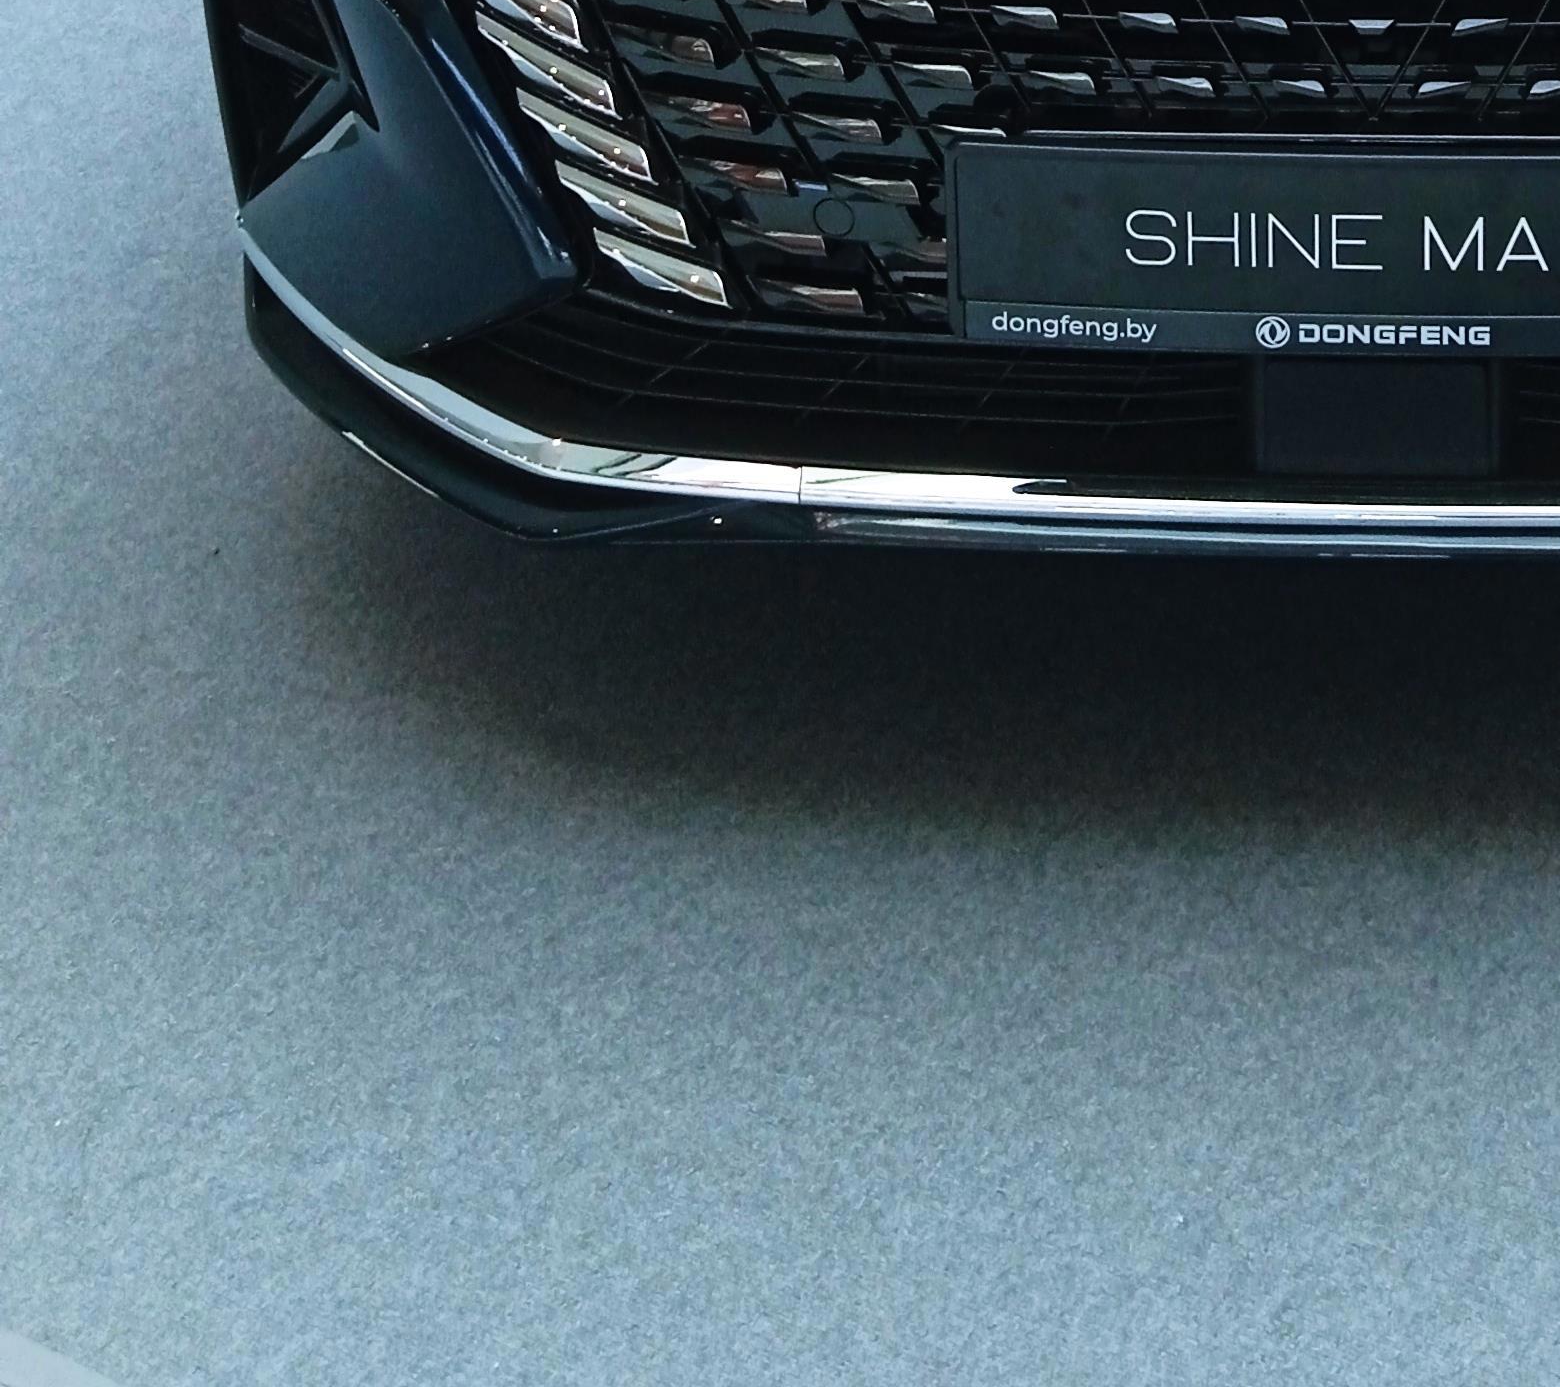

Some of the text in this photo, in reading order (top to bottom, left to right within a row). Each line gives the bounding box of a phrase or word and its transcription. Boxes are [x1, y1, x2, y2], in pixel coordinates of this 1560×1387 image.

[1125, 209, 1384, 271] SHINE
[992, 309, 1157, 343] dongfeng.by
[1299, 323, 1491, 347] DONGFENG
